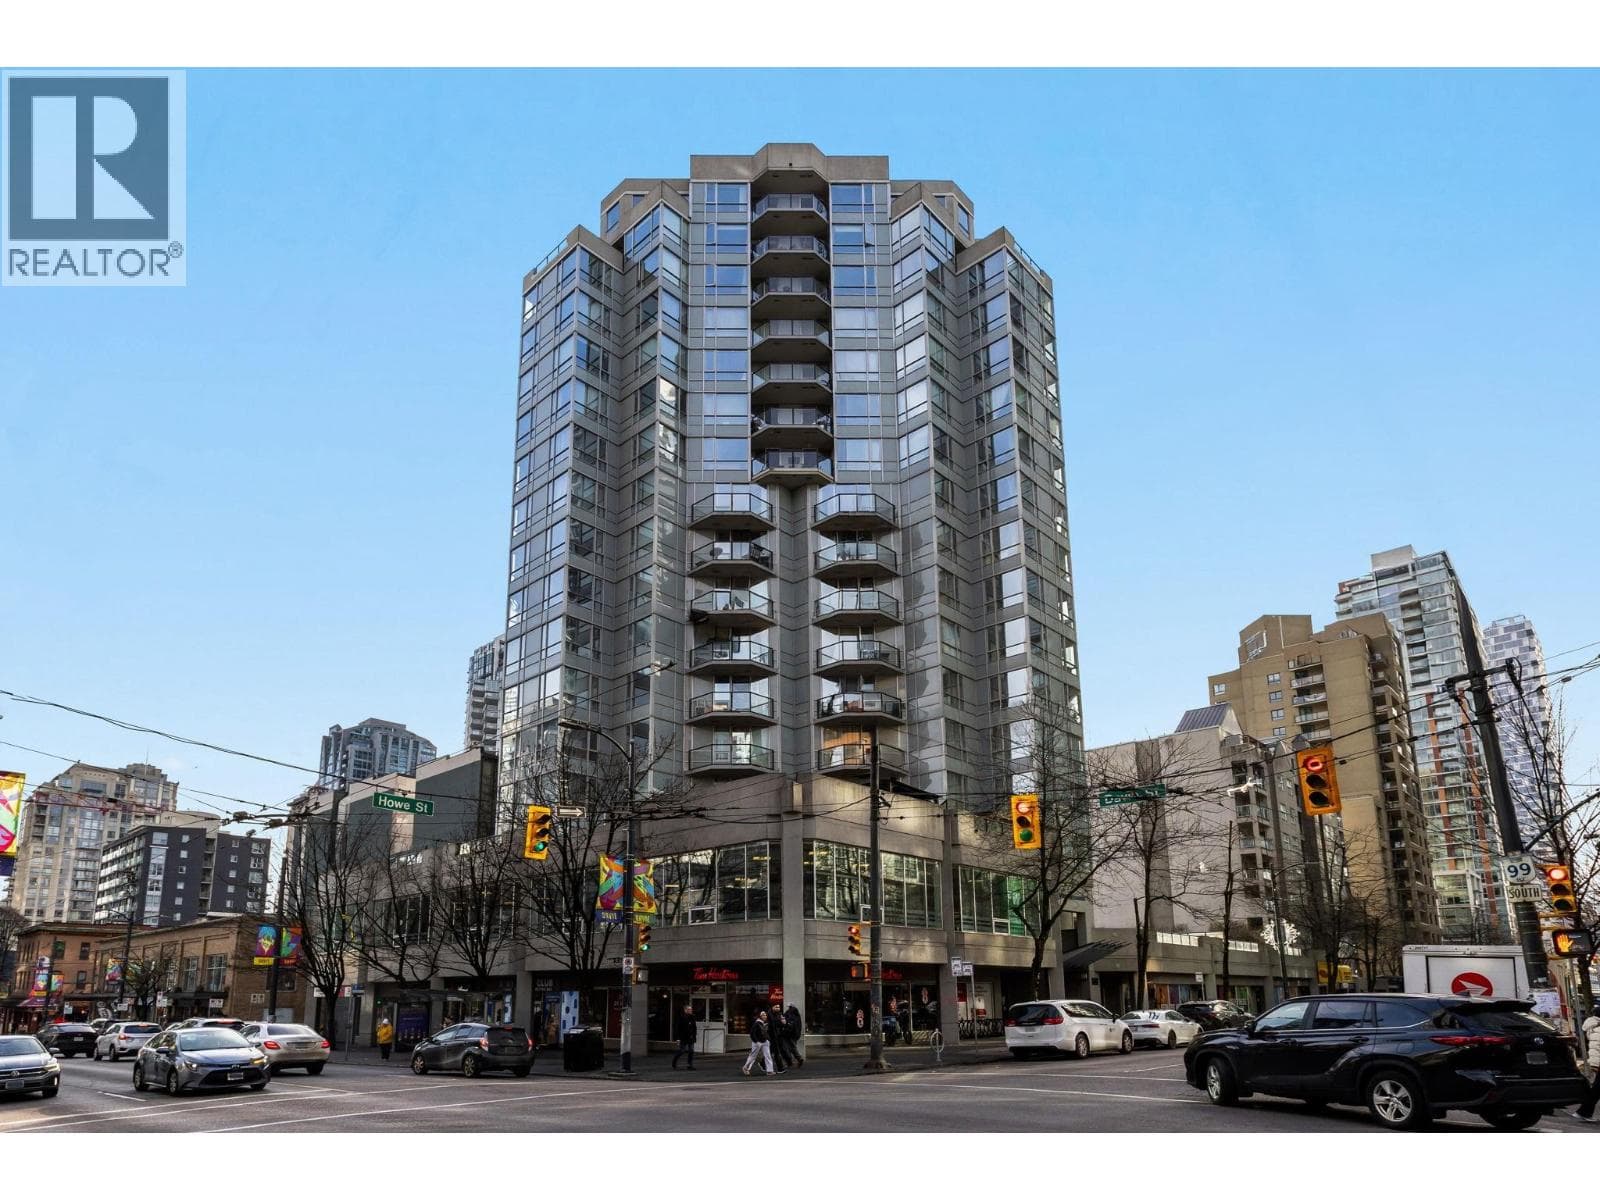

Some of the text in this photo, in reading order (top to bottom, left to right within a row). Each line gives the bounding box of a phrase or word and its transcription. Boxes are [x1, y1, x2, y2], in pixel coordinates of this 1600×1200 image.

[378, 795, 427, 813] Howe St
[1507, 863, 1531, 878] 99
[1508, 888, 1540, 899] SOUTH
